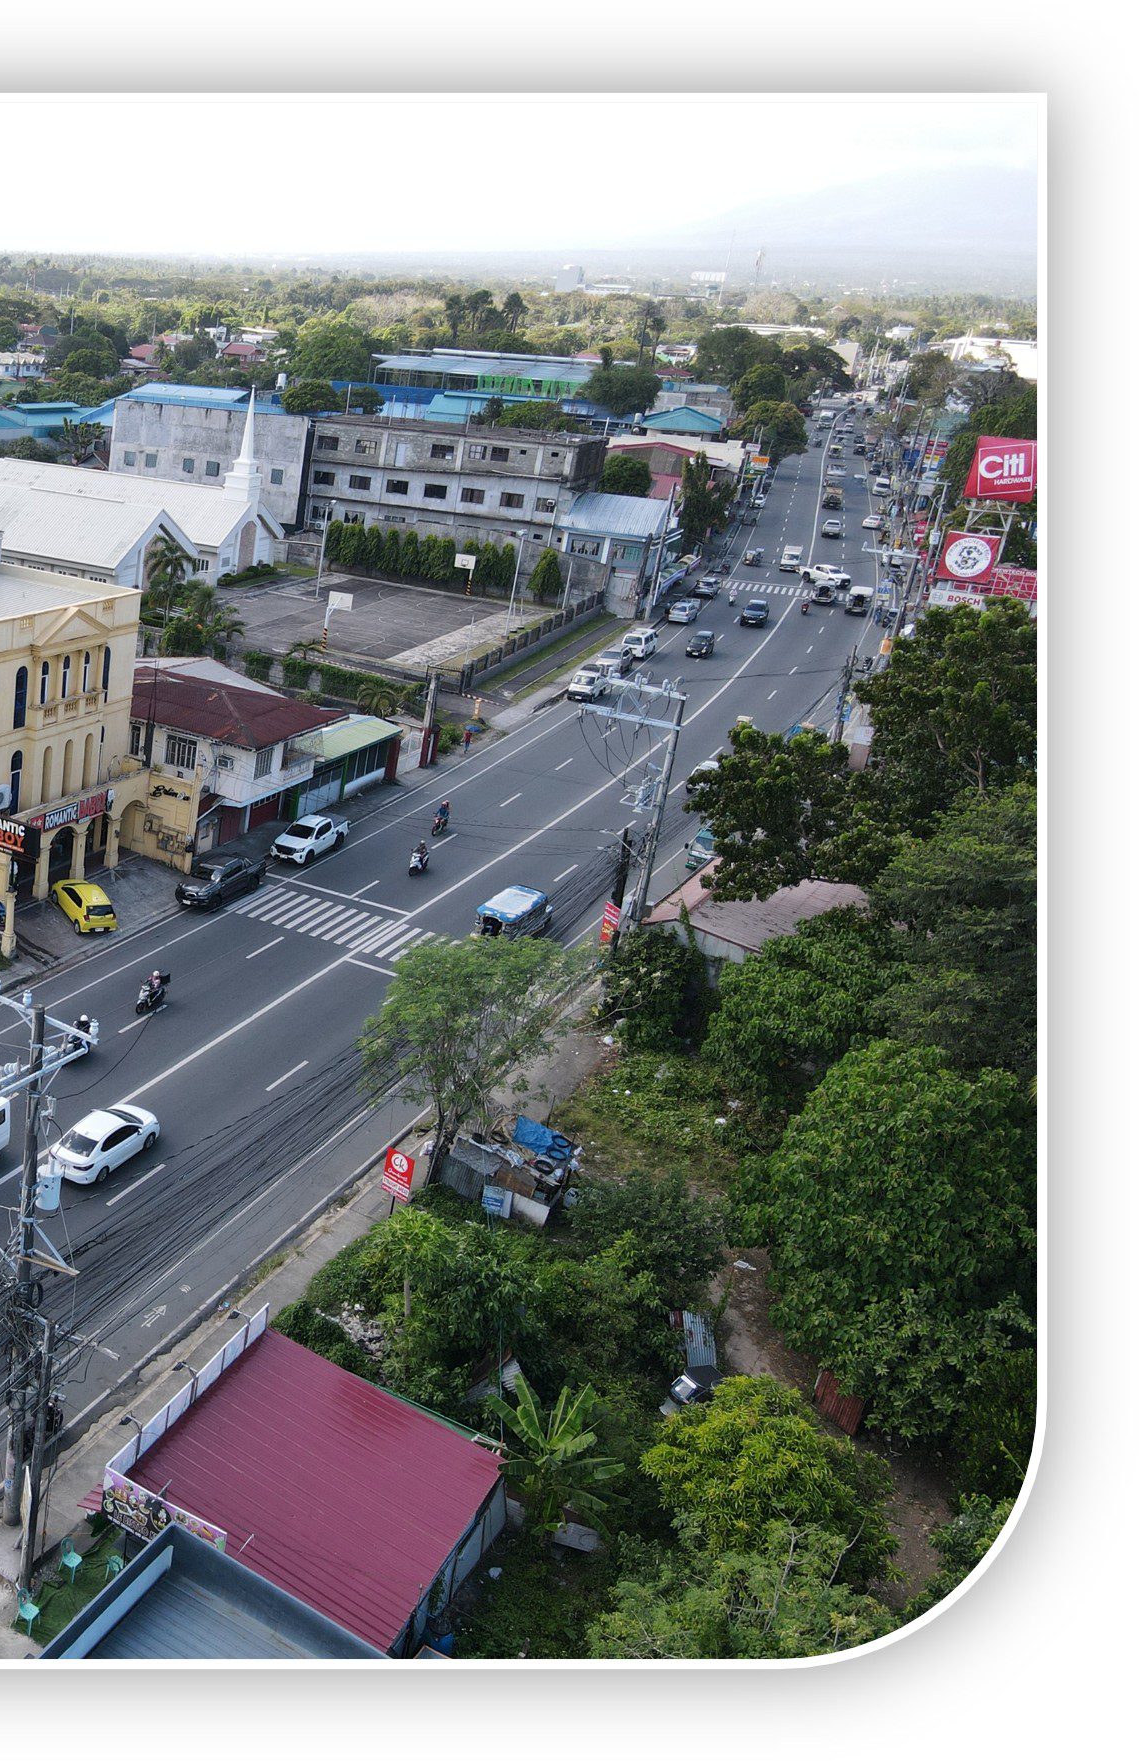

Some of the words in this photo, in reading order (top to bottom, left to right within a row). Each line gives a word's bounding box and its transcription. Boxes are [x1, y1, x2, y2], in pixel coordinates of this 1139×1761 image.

[979, 453, 1025, 478] Citi
[994, 476, 1032, 485] HARDWARE
[947, 594, 981, 606] BOSCH
[44, 806, 78, 830] ROMANTIC
[79, 790, 107, 819] BABOY
